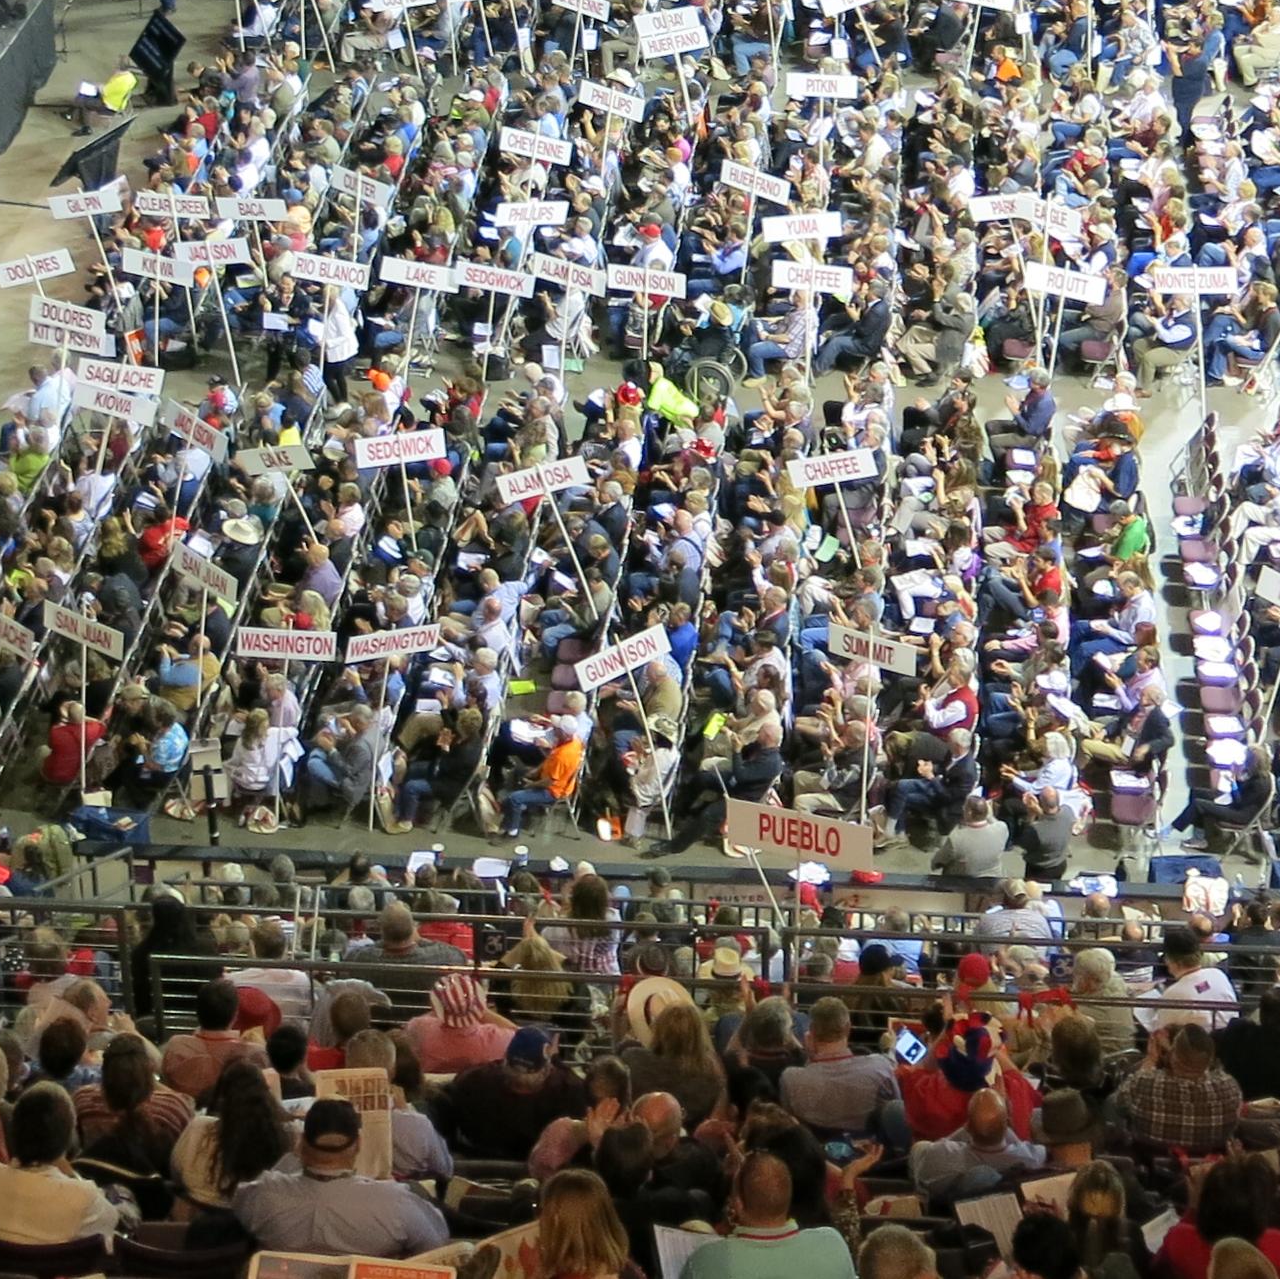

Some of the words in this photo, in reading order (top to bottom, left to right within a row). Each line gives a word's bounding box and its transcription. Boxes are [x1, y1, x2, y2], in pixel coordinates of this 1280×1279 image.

[651, 12, 685, 31] OURAY
[648, 30, 702, 55] HUERFANO
[805, 78, 838, 94] PITKIN
[590, 88, 634, 115] PHILLIPS
[507, 132, 566, 160] CHEYENNE
[729, 167, 782, 197] HUERFANO
[65, 195, 103, 214] GILPIN
[139, 196, 172, 212] CLEAR
[176, 198, 211, 216] CREEK
[238, 202, 267, 217] BACA
[508, 206, 556, 222] PHILLIPS
[785, 218, 819, 236] YUMA
[188, 244, 237, 262] JACSON
[5, 256, 61, 282] DOLORES
[296, 255, 315, 275] RIO
[319, 259, 366, 286] BLANCO
[404, 266, 437, 286] LAKE
[465, 267, 525, 292] SEDGWICK
[541, 260, 594, 289] ALAMOSA
[614, 270, 676, 293] GUNNISON
[786, 267, 842, 289] CHAFFEE
[1046, 271, 1090, 296] ROUTT
[1156, 273, 1230, 292] MONTEZUMA
[41, 302, 94, 330] DOLORES
[34, 323, 52, 341] KIT
[54, 327, 102, 350] CRSON
[84, 362, 156, 390] SAGUACHE
[93, 392, 133, 415] KIOWA
[366, 435, 436, 463] SEDGWICK
[508, 463, 573, 497] ALAMOSA
[804, 456, 861, 483] CHAFFEE
[181, 551, 203, 572] SAN
[203, 563, 230, 595] JUAN
[54, 613, 80, 633] SAN
[82, 622, 113, 651] JUAN
[239, 631, 334, 657] WASHINGTON
[350, 629, 438, 658] WASHINGTON
[583, 637, 658, 683] GUNNISON
[841, 633, 895, 665] SUMMIT
[758, 812, 842, 858] PUEBLO
[367, 1266, 393, 1277] VOTE
[394, 1267, 413, 1277] FOR
